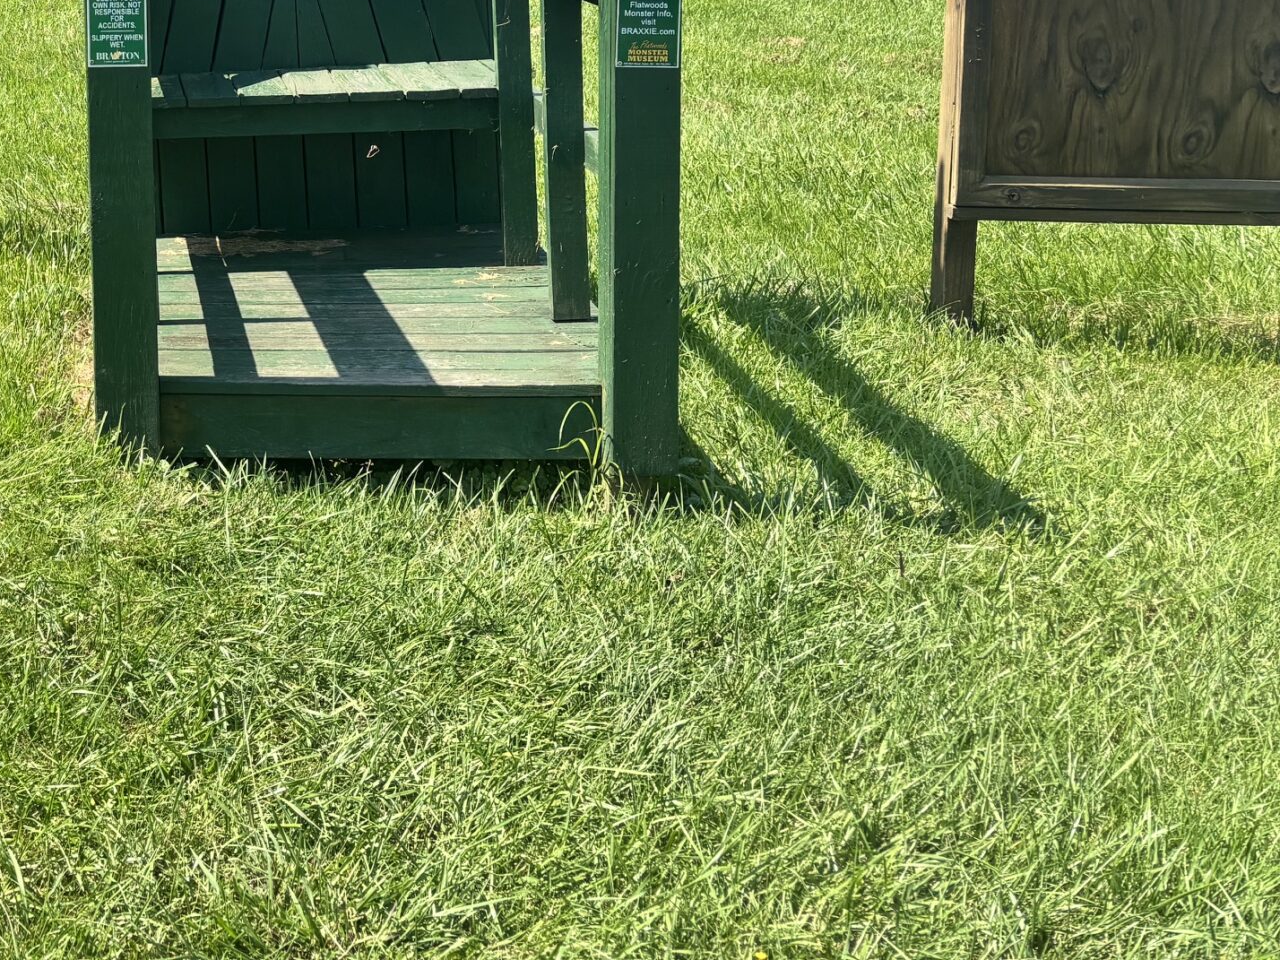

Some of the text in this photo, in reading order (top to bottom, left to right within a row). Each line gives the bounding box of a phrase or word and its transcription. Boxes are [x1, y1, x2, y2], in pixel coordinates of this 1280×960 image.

[629, 1, 669, 9] Flatwoods
[621, 27, 676, 35] BRAXXIE.com
[96, 50, 140, 60] BRATON
